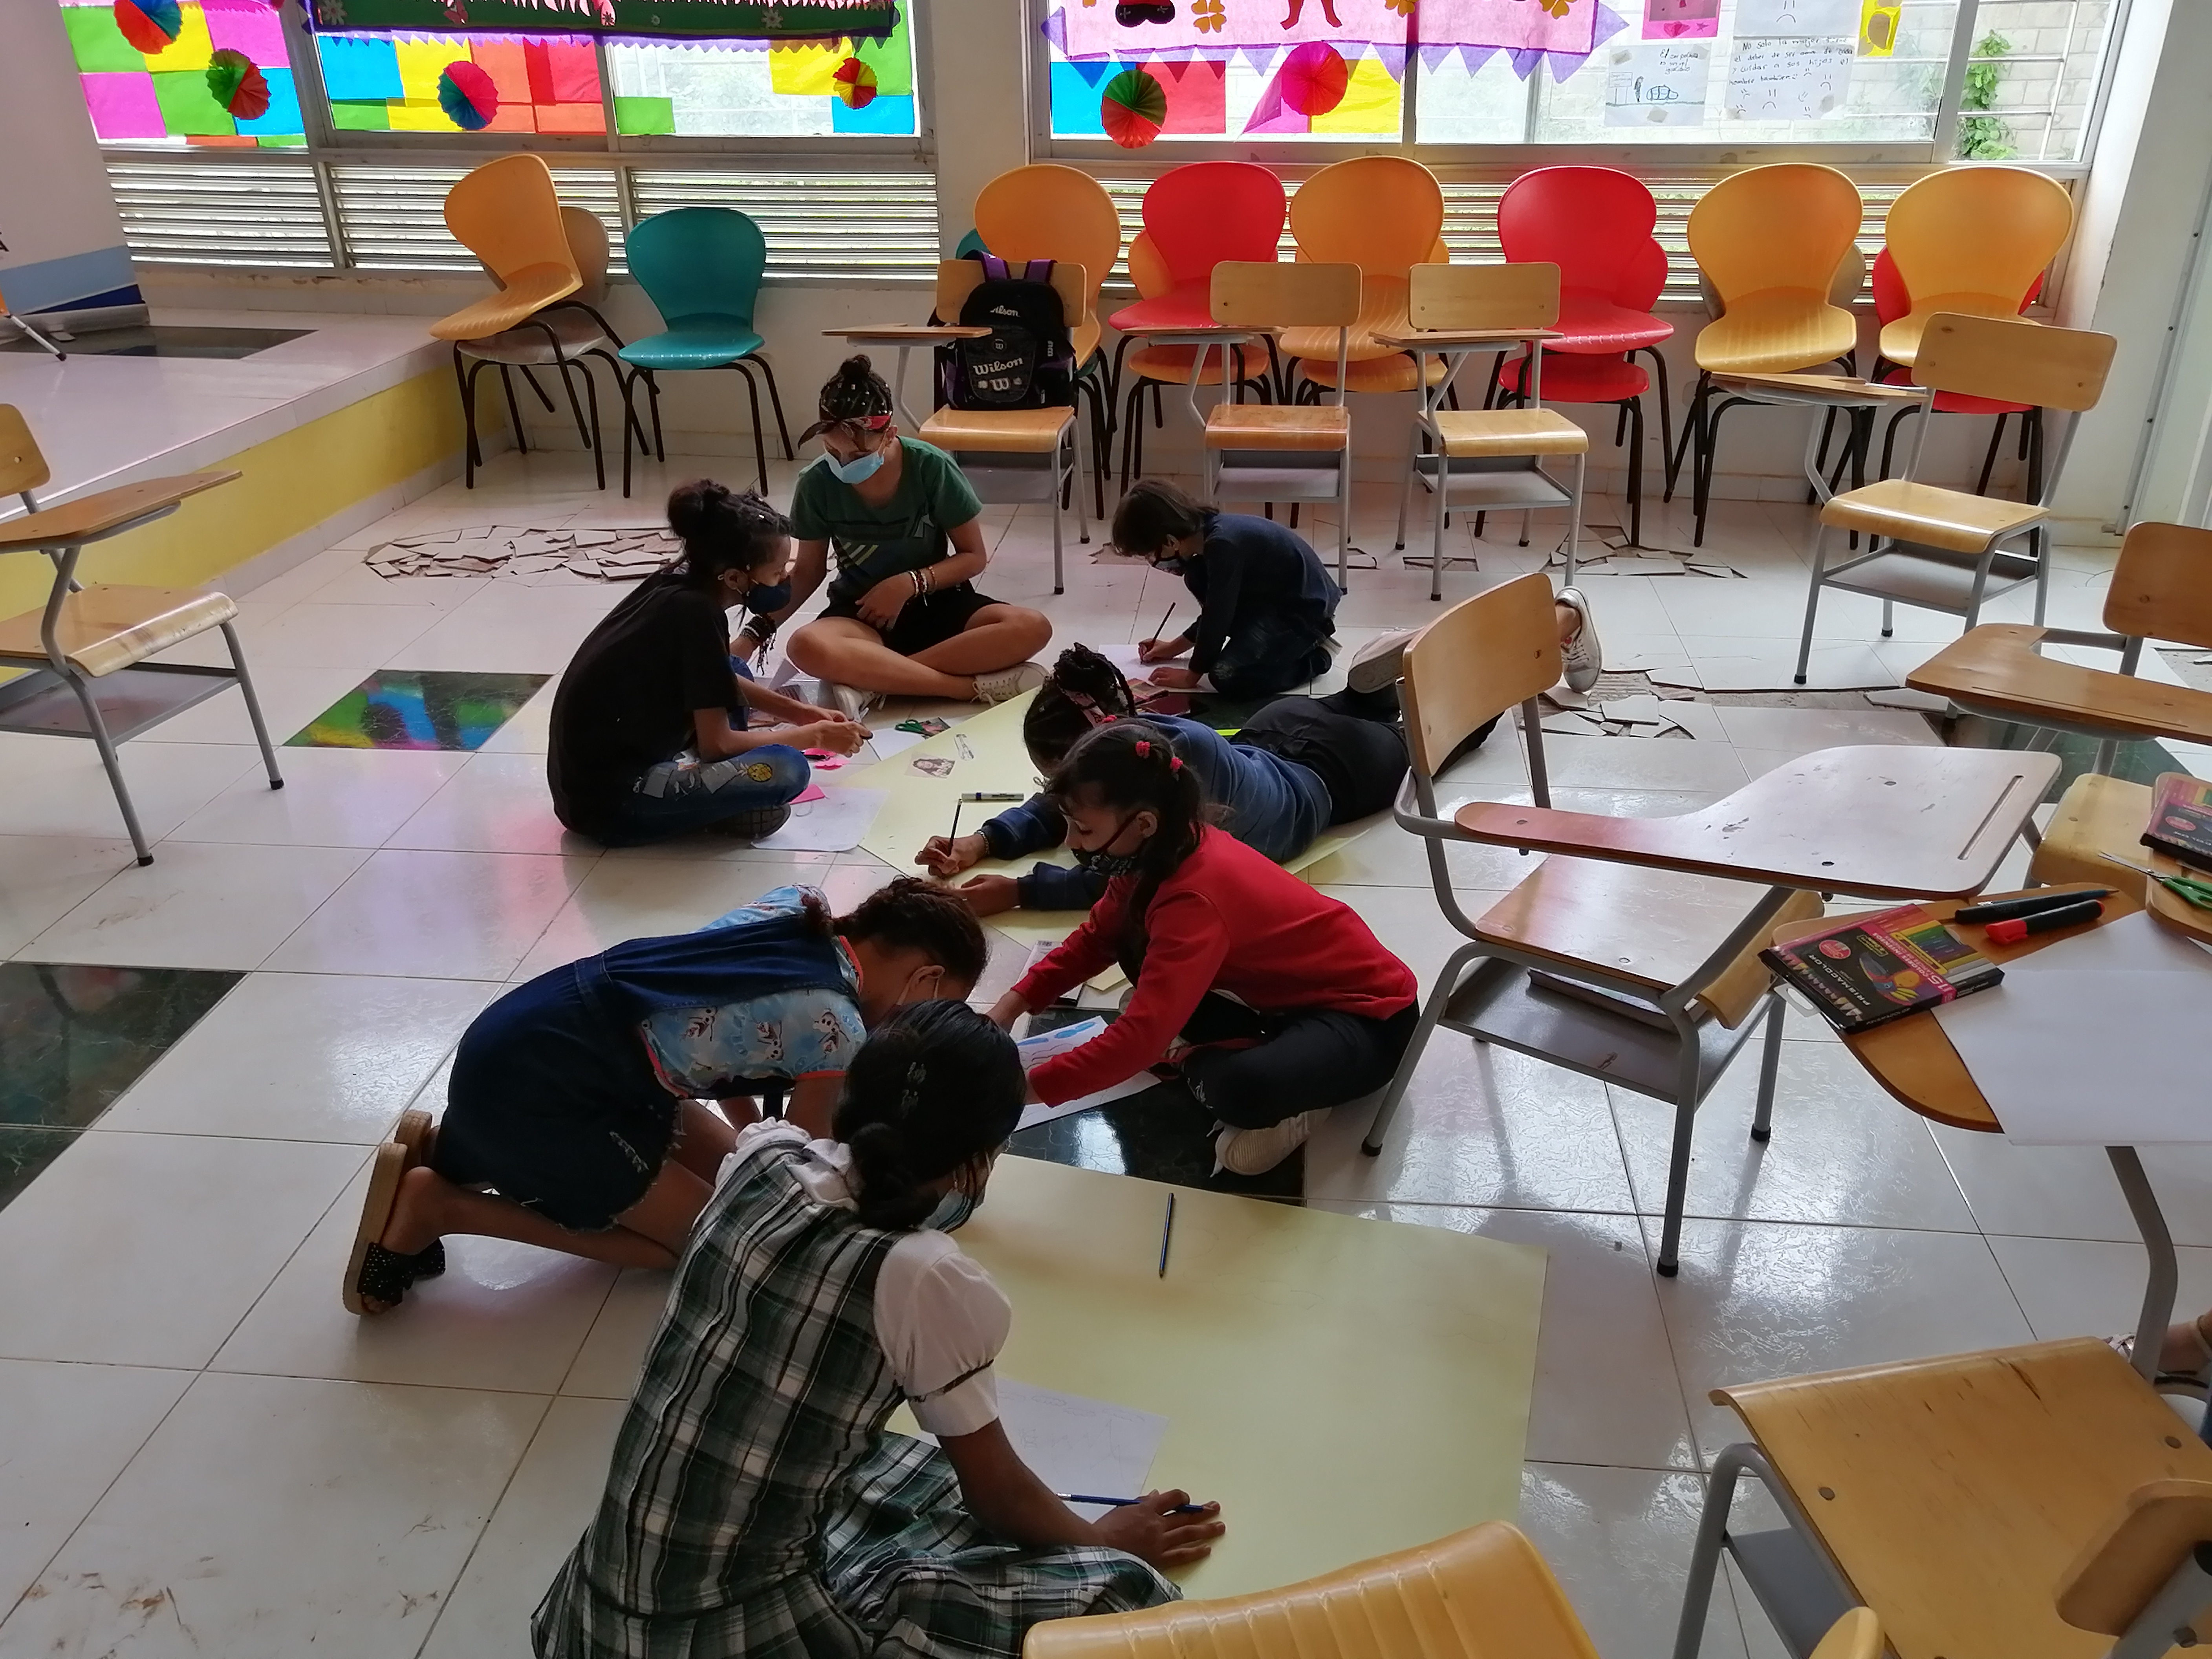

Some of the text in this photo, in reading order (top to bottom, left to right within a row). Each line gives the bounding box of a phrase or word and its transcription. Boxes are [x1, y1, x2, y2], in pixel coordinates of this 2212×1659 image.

[1778, 38, 1787, 46] la
[1740, 63, 1768, 73] cuidar
[1809, 58, 1833, 67] hijos
[973, 357, 1024, 375] Wilson
[1872, 932, 1903, 956] INTENSOS
[1901, 955, 1930, 978] COLORES
[1808, 954, 1871, 1005] PRISMACOLOR
[1927, 974, 1949, 991] 15
